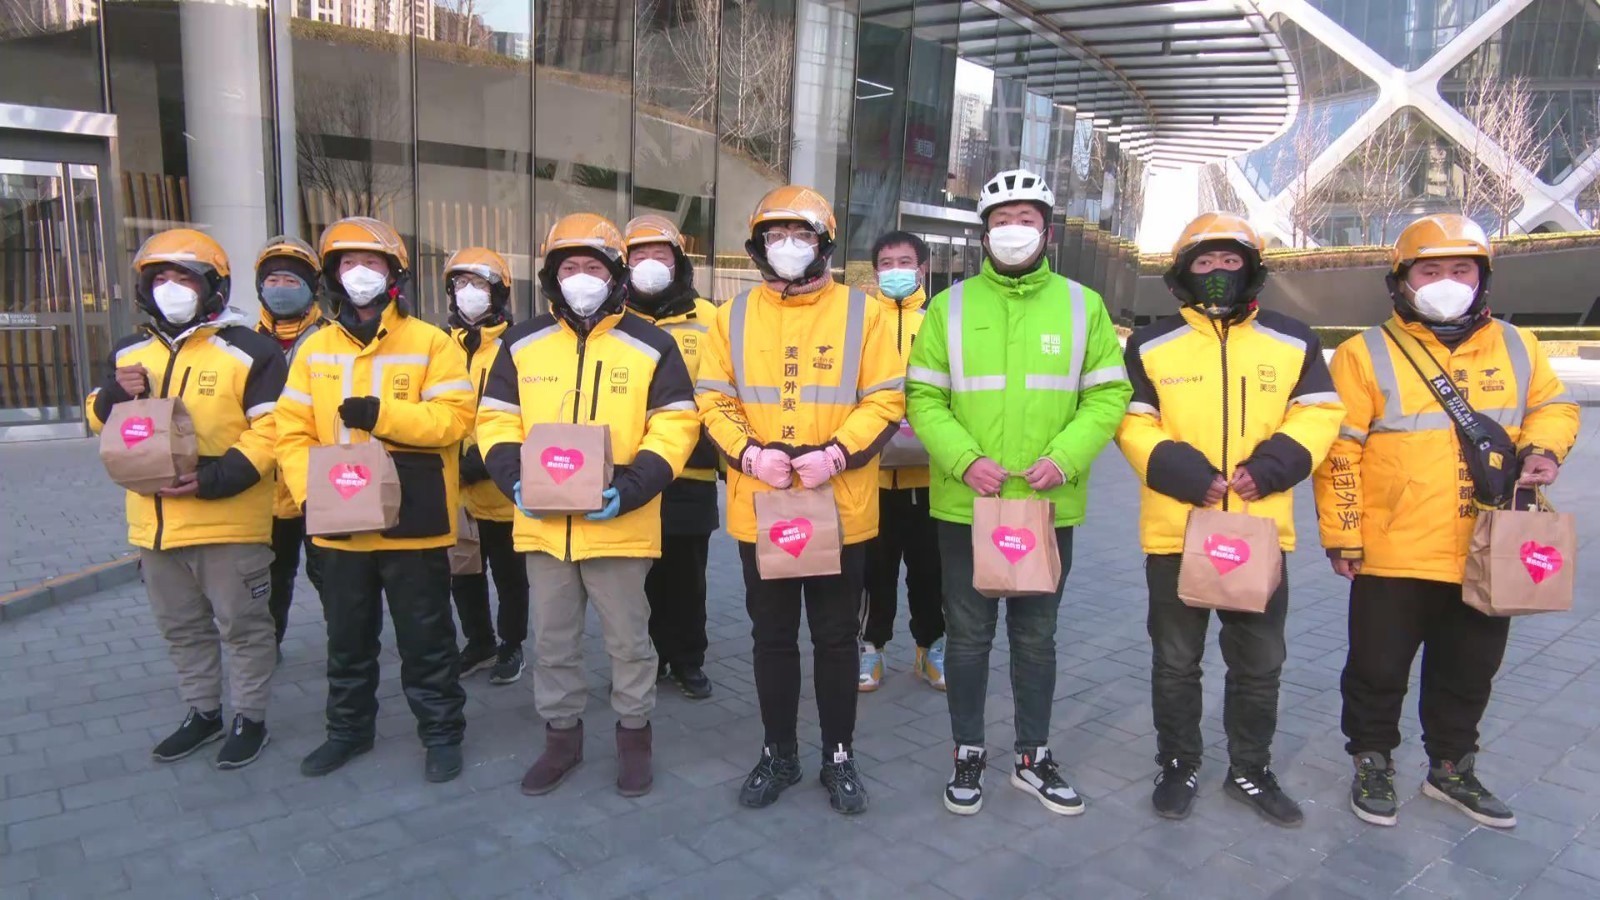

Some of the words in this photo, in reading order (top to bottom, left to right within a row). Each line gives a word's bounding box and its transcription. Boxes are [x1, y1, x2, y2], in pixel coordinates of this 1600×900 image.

[783, 346, 798, 412] 美团外卖
[1433, 379, 1452, 395] AC
[782, 425, 795, 440] 送
[1331, 456, 1360, 531] 美团外卖
